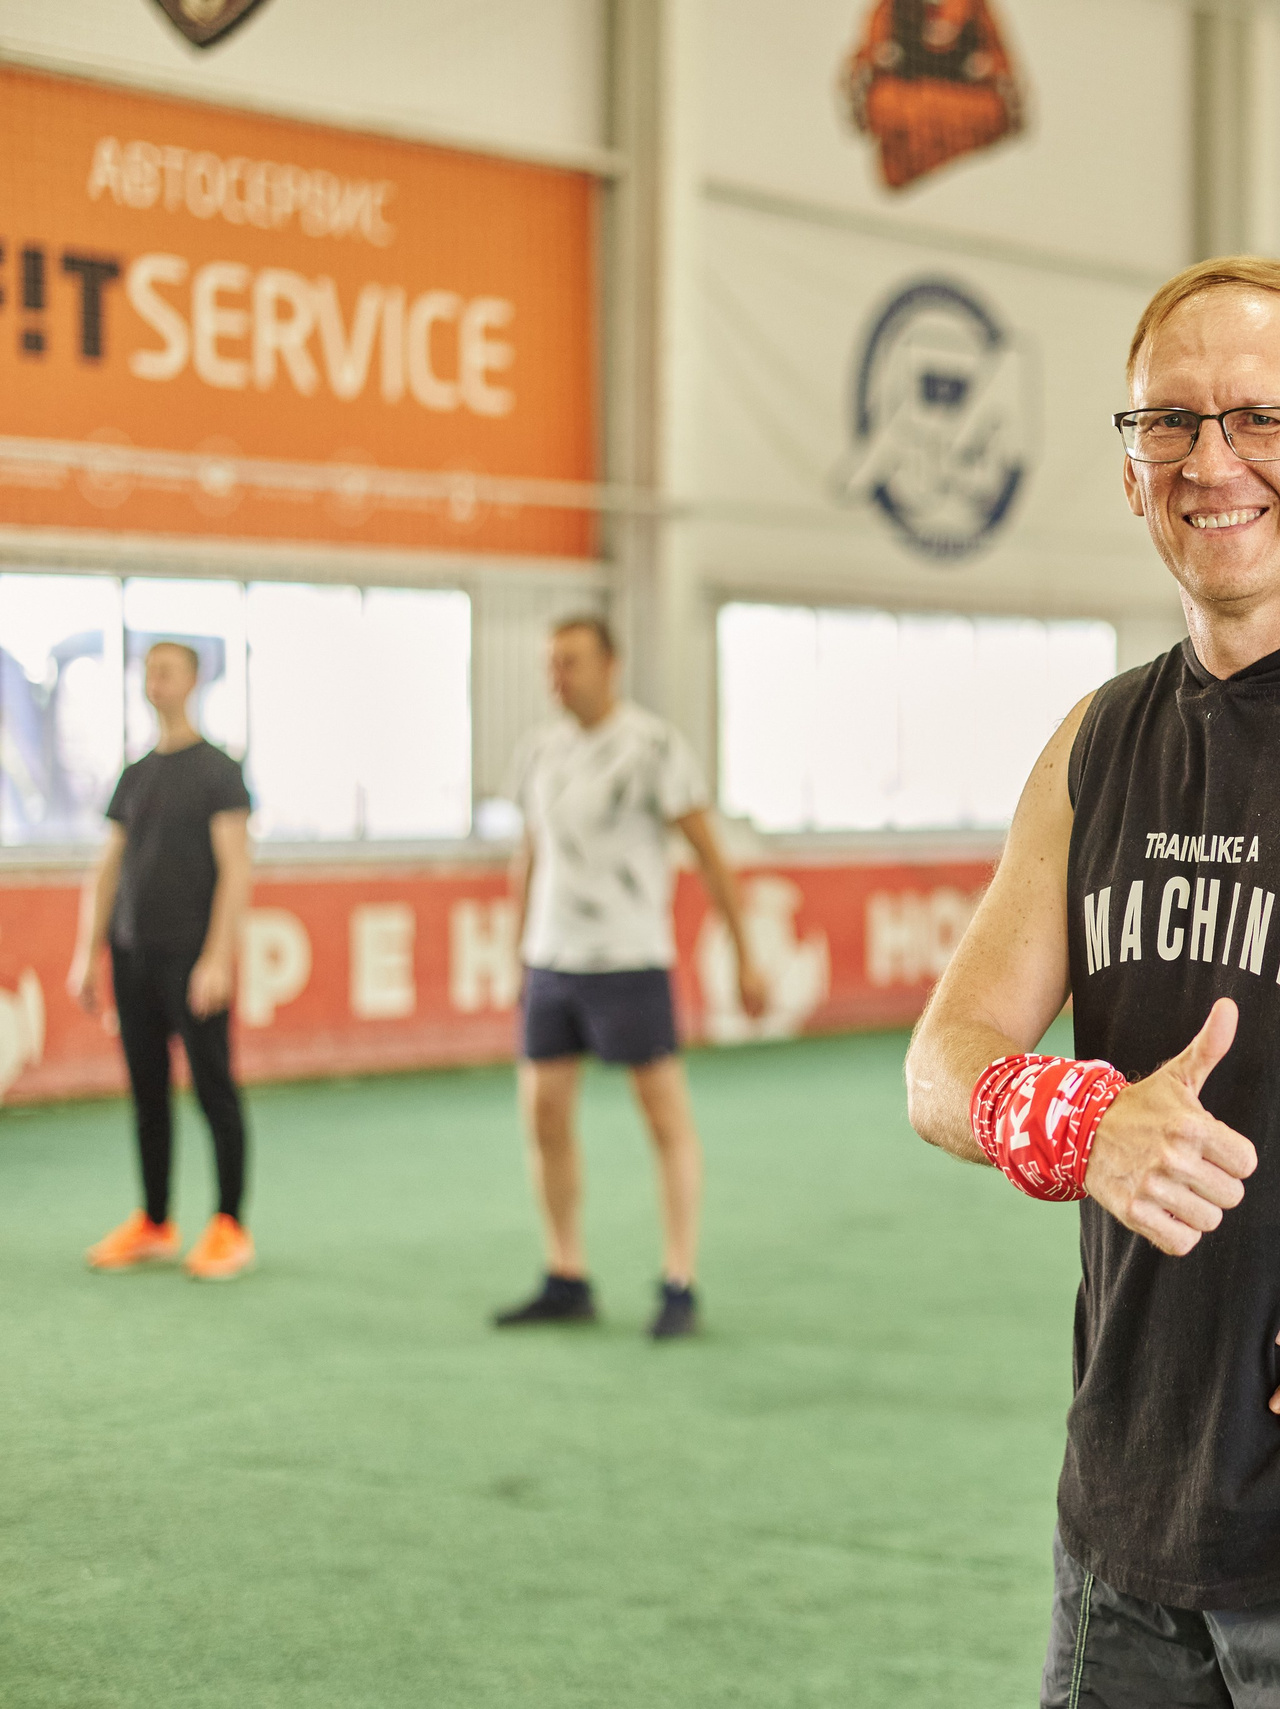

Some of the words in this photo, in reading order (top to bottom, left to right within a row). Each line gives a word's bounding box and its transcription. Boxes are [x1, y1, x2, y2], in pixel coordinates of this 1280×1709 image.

[87, 136, 397, 247] АВТОСЕРВИС
[1201, 834, 1244, 863] LIKE
[1246, 835, 1259, 862] A
